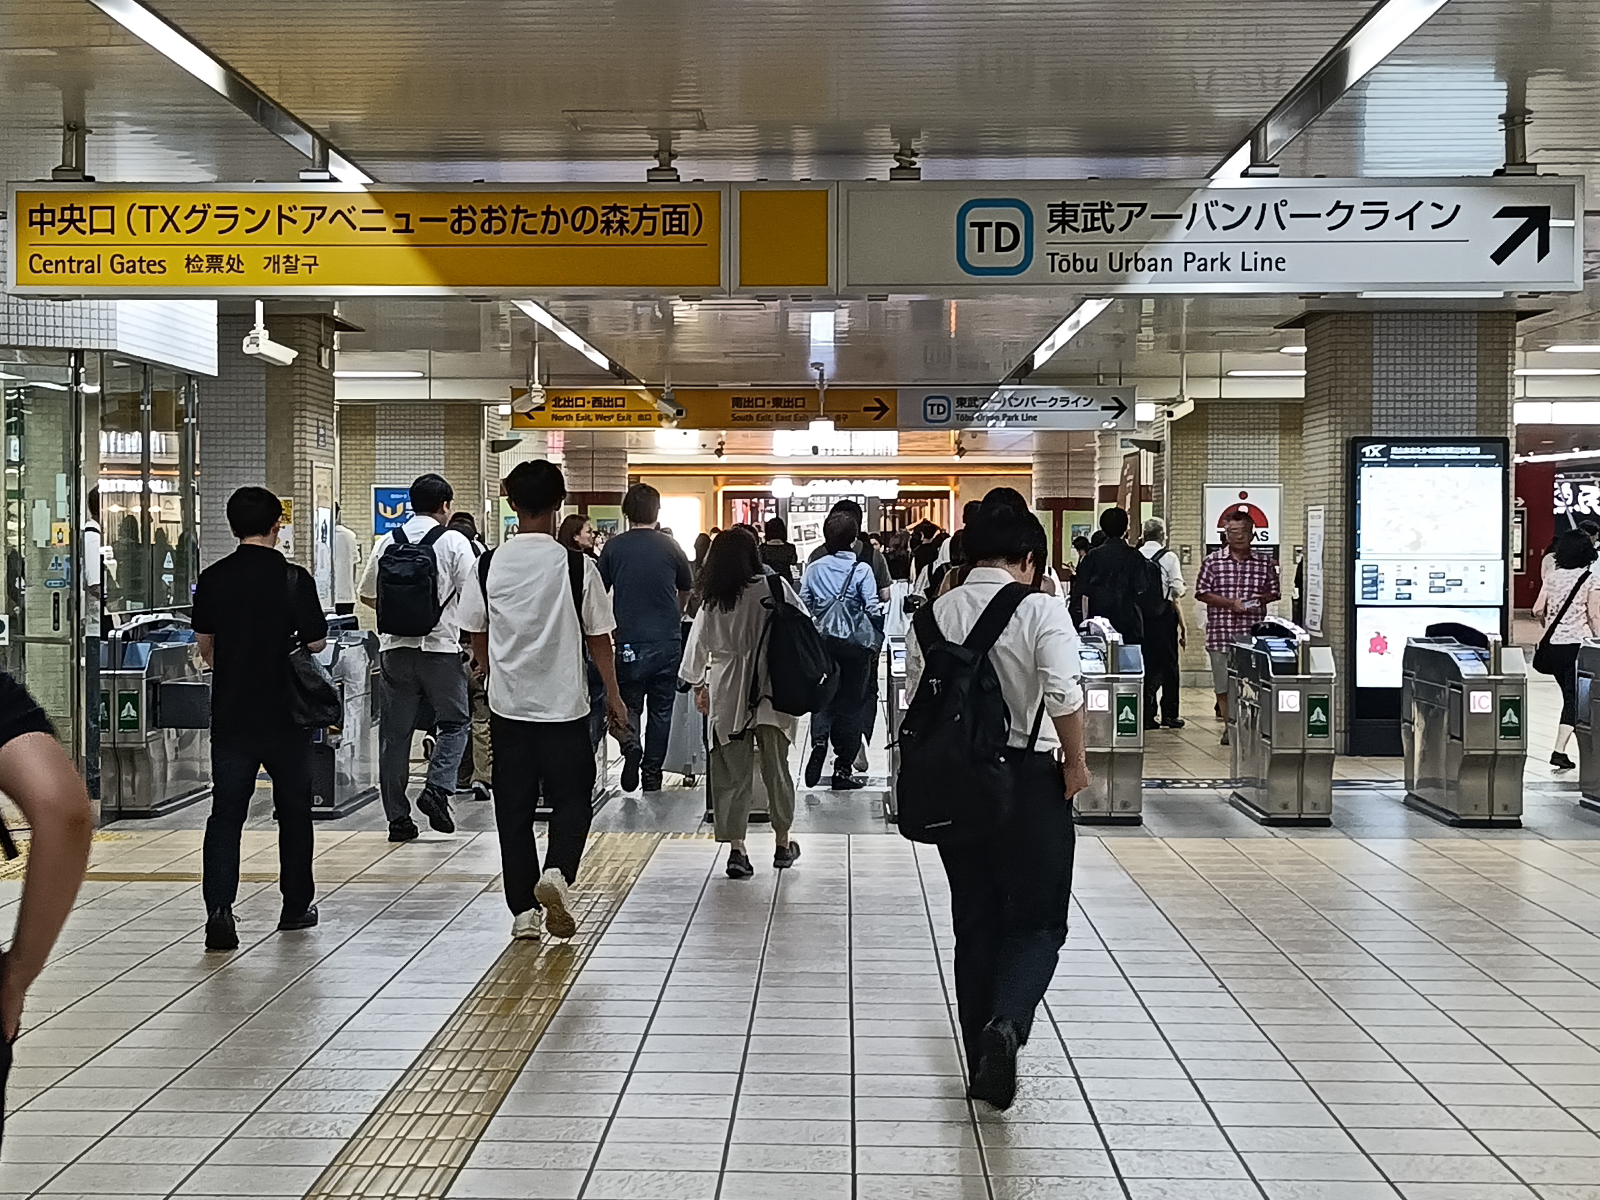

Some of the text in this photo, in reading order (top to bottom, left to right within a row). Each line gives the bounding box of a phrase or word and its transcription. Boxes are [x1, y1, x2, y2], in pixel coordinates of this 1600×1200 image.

[1046, 200, 1462, 234] 東武アーバンパークライン
[969, 221, 1021, 254] TD
[28, 253, 320, 275] Central Gates 检票处 개찰구
[1046, 251, 1287, 273] Tōbu Urban Park Line
[927, 403, 947, 416] TD
[1002, 412, 1019, 422] Park
[1021, 412, 1038, 422] Line
[551, 413, 574, 422] North
[617, 413, 632, 422] Exit
[731, 413, 754, 422] South
[1217, 530, 1269, 542] TAS
[1089, 693, 1109, 709] IC
[1281, 694, 1299, 709] IC
[1472, 695, 1490, 710] IC
